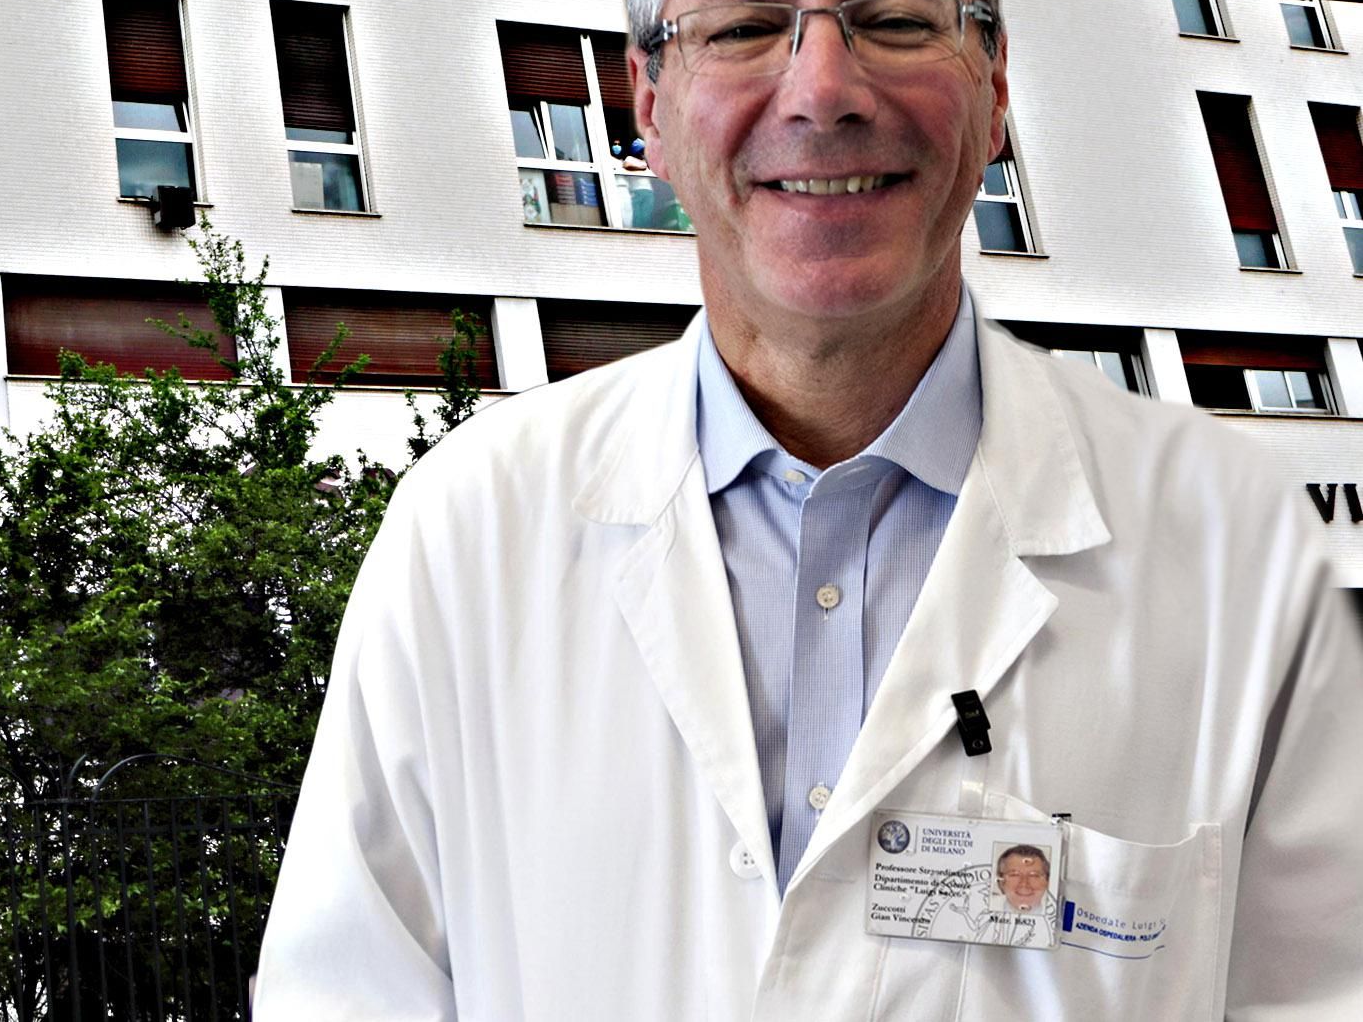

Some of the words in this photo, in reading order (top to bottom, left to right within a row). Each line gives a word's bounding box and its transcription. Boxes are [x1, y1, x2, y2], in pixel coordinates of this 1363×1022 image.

[922, 828, 971, 839] UNIVERSITÀ
[921, 836, 946, 845] DEGLI
[948, 838, 974, 847] STUDI
[920, 845, 930, 853] DI
[931, 846, 966, 855] MILANO
[875, 863, 917, 874] Professore
[874, 874, 929, 884] Dipartimento
[873, 883, 907, 892] Cliniche
[871, 903, 906, 913] Zuccotti
[870, 912, 891, 921] Gian
[1076, 907, 1127, 929] Ospedale
[1098, 929, 1137, 942] OSPEDALIERA
